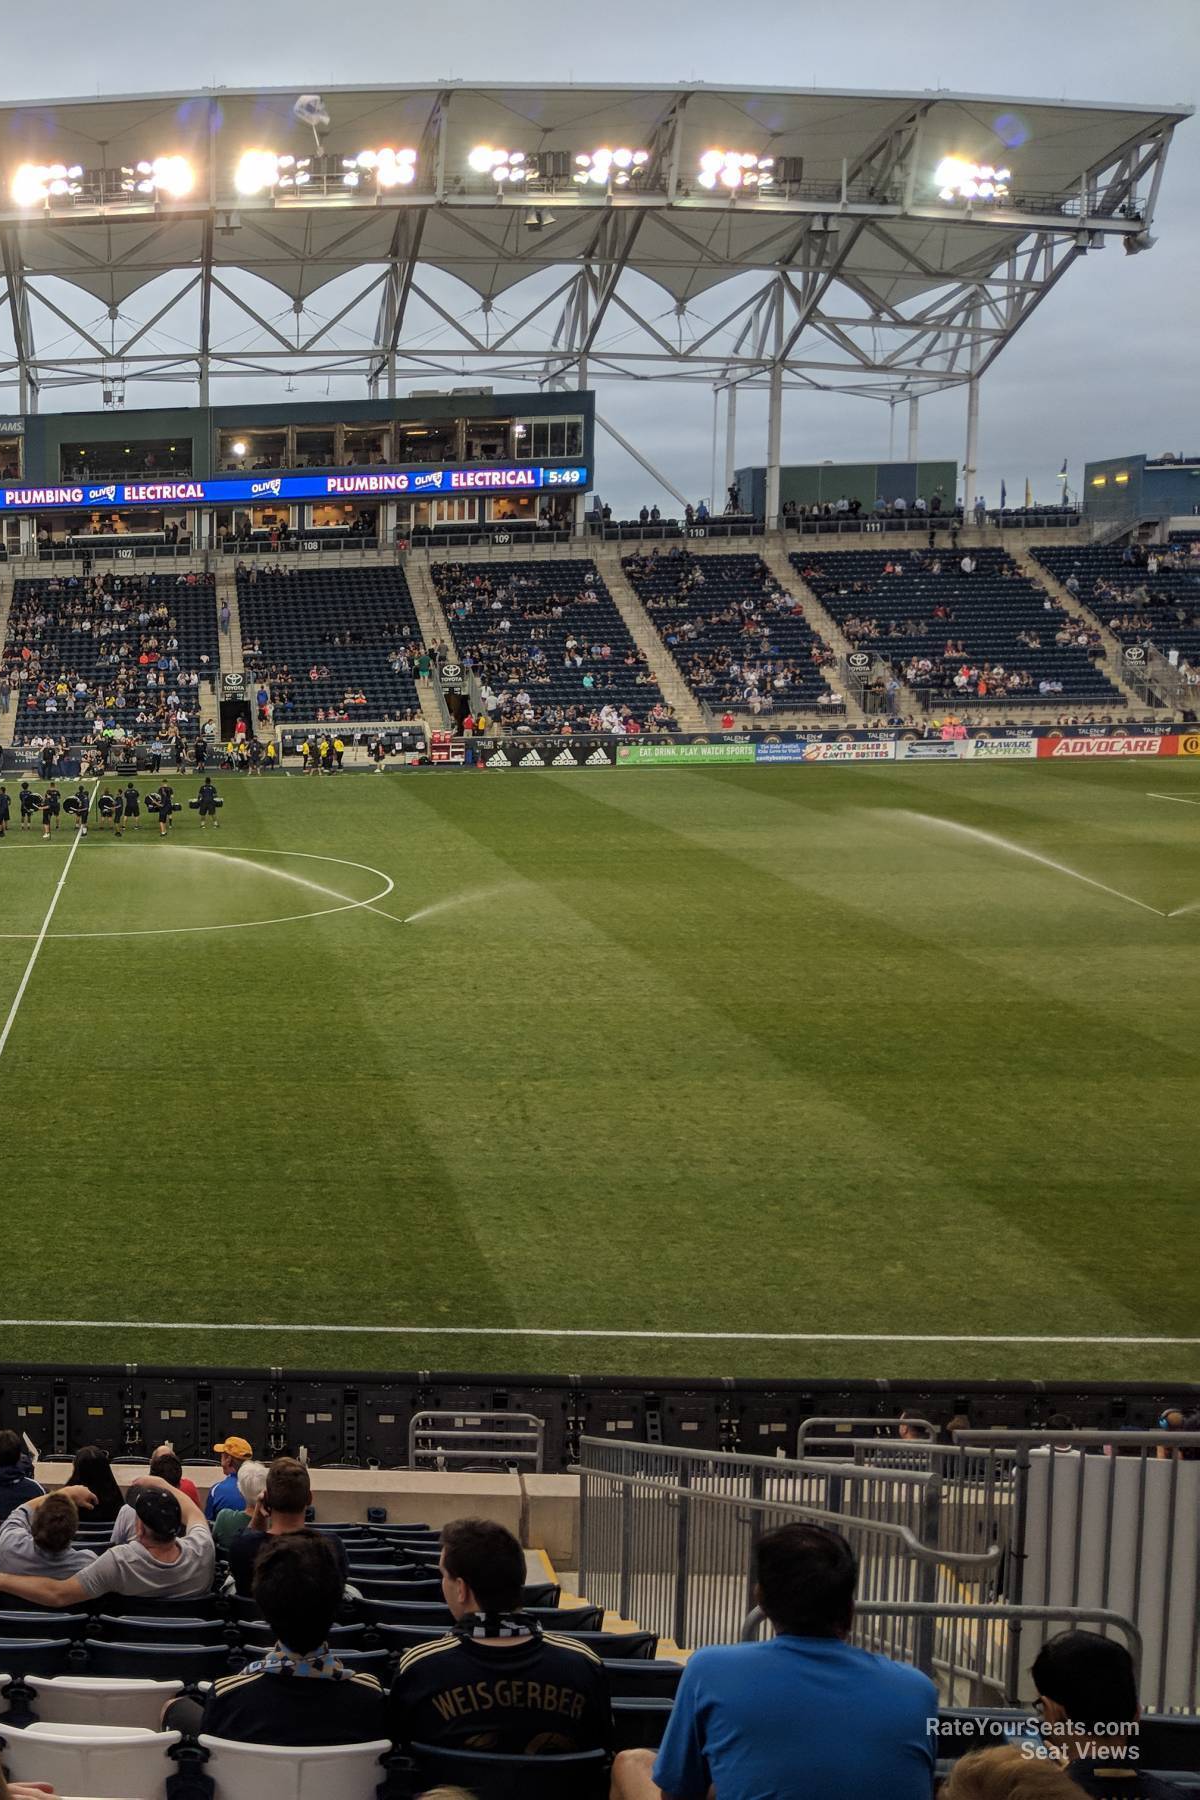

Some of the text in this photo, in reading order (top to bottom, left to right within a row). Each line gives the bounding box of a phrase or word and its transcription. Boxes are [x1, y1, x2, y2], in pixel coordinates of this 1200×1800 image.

[5, 489, 83, 504] PLUMBING
[89, 485, 116, 501] OLIVER
[124, 484, 204, 499] ELECTRICAL
[252, 479, 281, 496] OLIVER
[327, 476, 409, 491] PLUMBING
[415, 472, 442, 488] OLIVER
[451, 470, 535, 486] ELECTRICAL
[549, 471, 580, 482] 5:49
[494, 534, 510, 543] 109
[303, 541, 318, 550] 108
[117, 550, 132, 558] 107
[974, 740, 1032, 748] DELAWARE
[1056, 738, 1161, 754] ADVOCARE
[654, 748, 678, 757] DRINK.
[701, 747, 724, 755] WATCH
[974, 748, 1032, 757] EXPRESS
[519, 759, 545, 767] adidas
[552, 758, 578, 766] adidas
[432, 1681, 586, 1721] WEISGERBER
